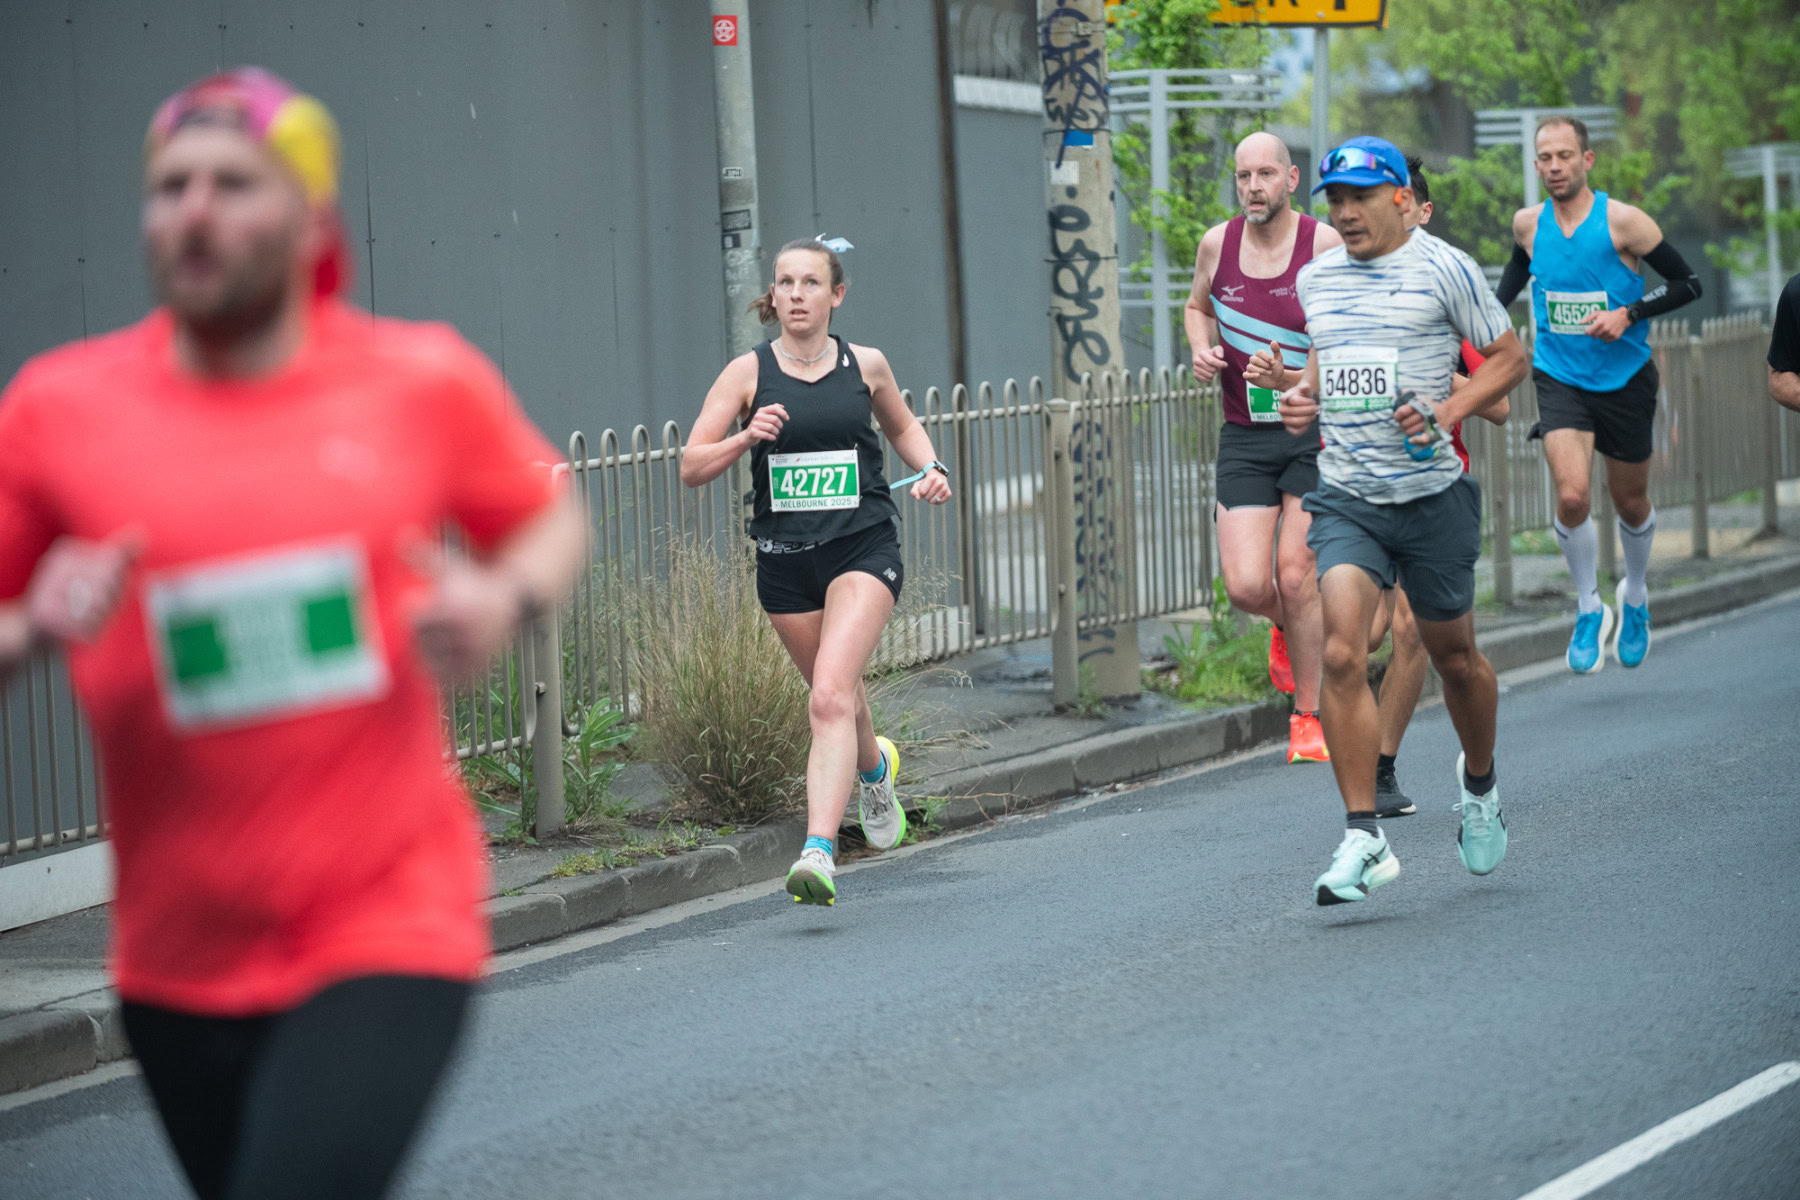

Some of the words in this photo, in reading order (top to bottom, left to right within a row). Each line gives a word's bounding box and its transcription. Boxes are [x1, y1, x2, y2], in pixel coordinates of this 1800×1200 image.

[1326, 367, 1387, 396] 54836
[780, 466, 848, 497] 42727
[780, 499, 828, 509] MELBOURNE
[831, 498, 851, 506] 2025
